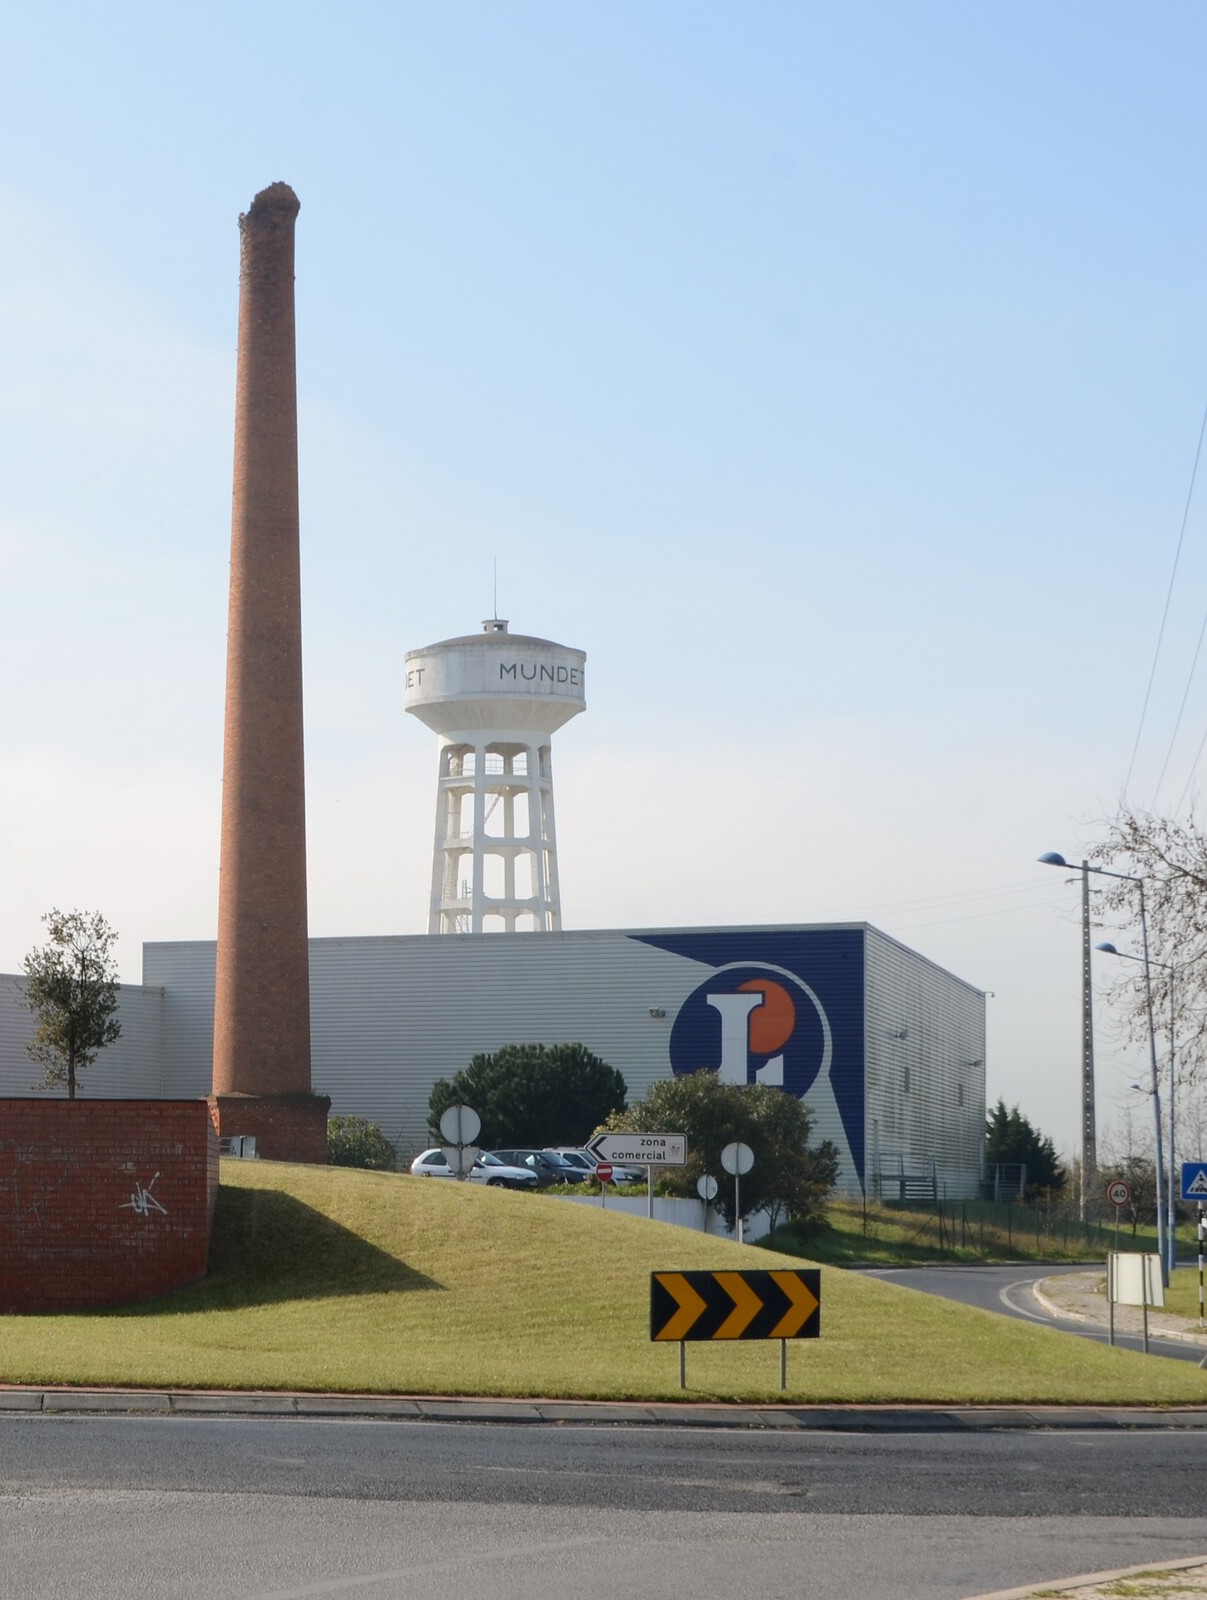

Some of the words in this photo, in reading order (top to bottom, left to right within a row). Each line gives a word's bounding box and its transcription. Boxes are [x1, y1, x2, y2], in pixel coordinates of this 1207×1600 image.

[640, 1138, 667, 1147] zona
[611, 1151, 667, 1160] comercial
[1113, 1189, 1126, 1198] 40
